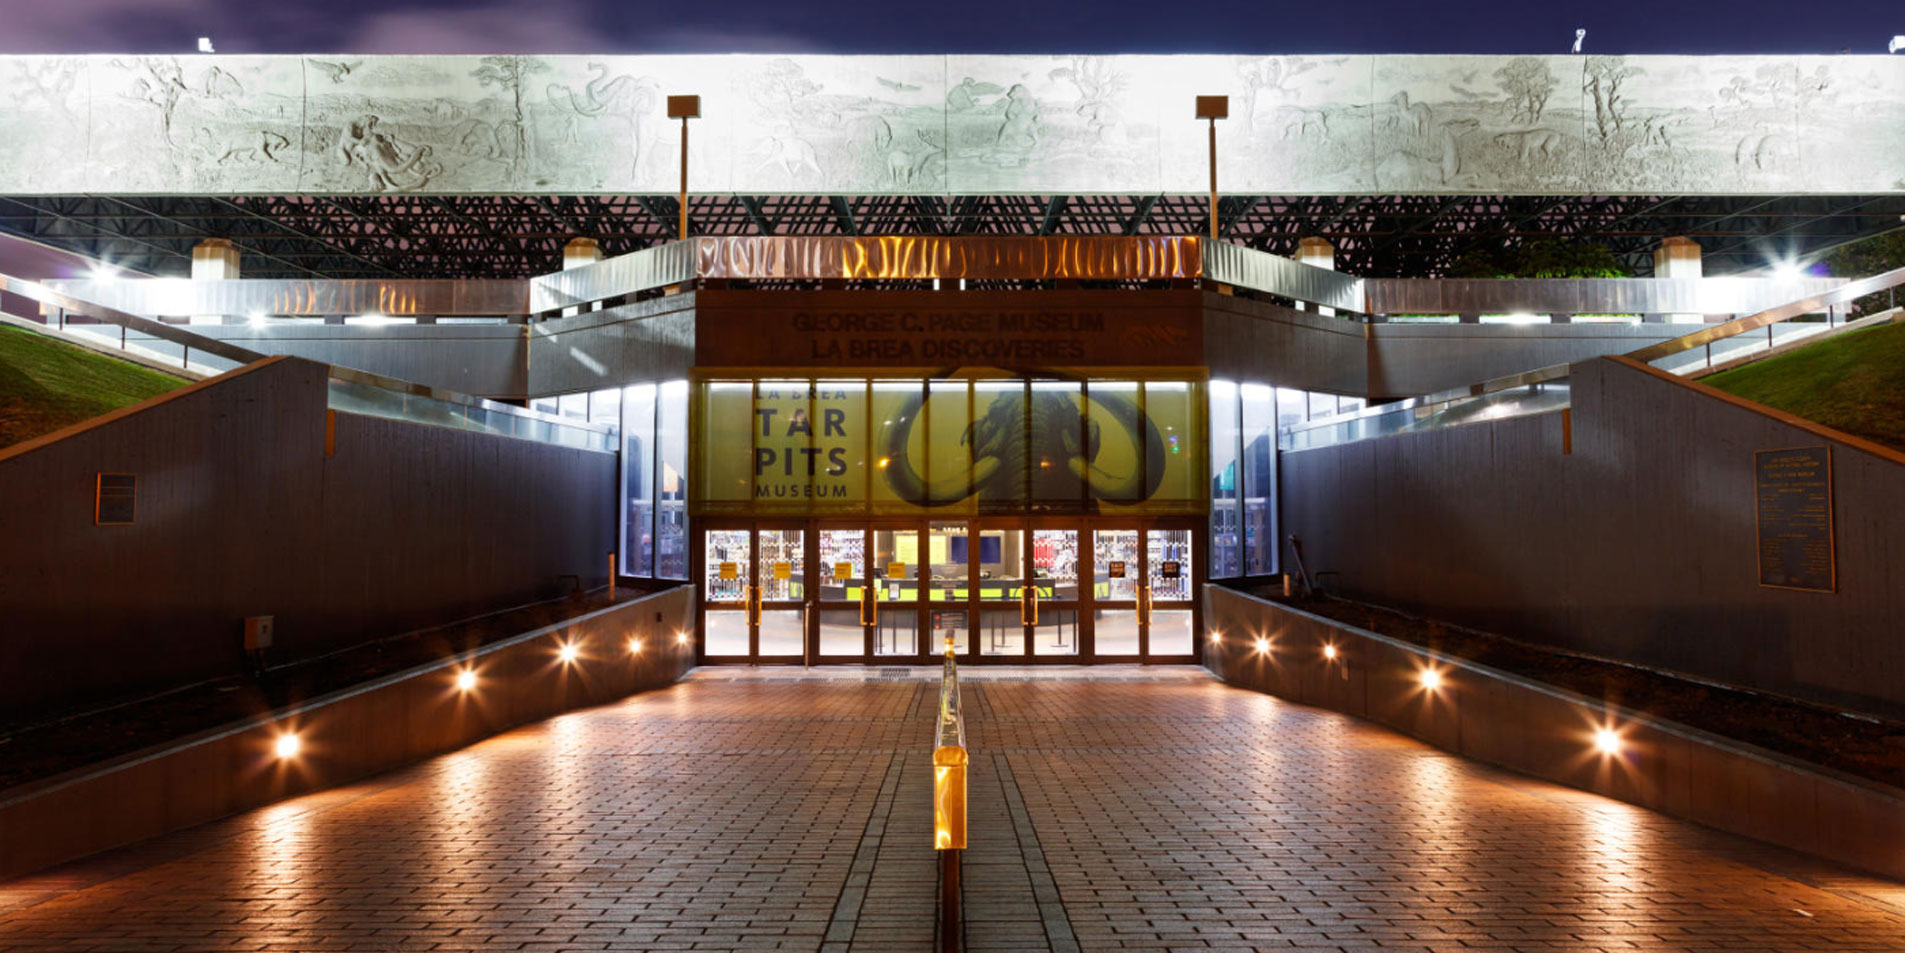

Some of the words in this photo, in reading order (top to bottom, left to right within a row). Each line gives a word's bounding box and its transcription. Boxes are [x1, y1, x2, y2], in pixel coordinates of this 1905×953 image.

[794, 313, 895, 332] GEORGE
[901, 313, 923, 332] C.
[929, 313, 990, 332] PAGE
[998, 313, 1104, 332] MUSEUM
[812, 340, 841, 358] LA
[850, 340, 914, 358] BREA
[922, 340, 1085, 358] DISCOVERIES
[756, 387, 780, 400] LA
[792, 387, 847, 400] BREA
[756, 409, 847, 437] TAR
[756, 447, 847, 476] PITS
[756, 485, 847, 498] MUSEUM
